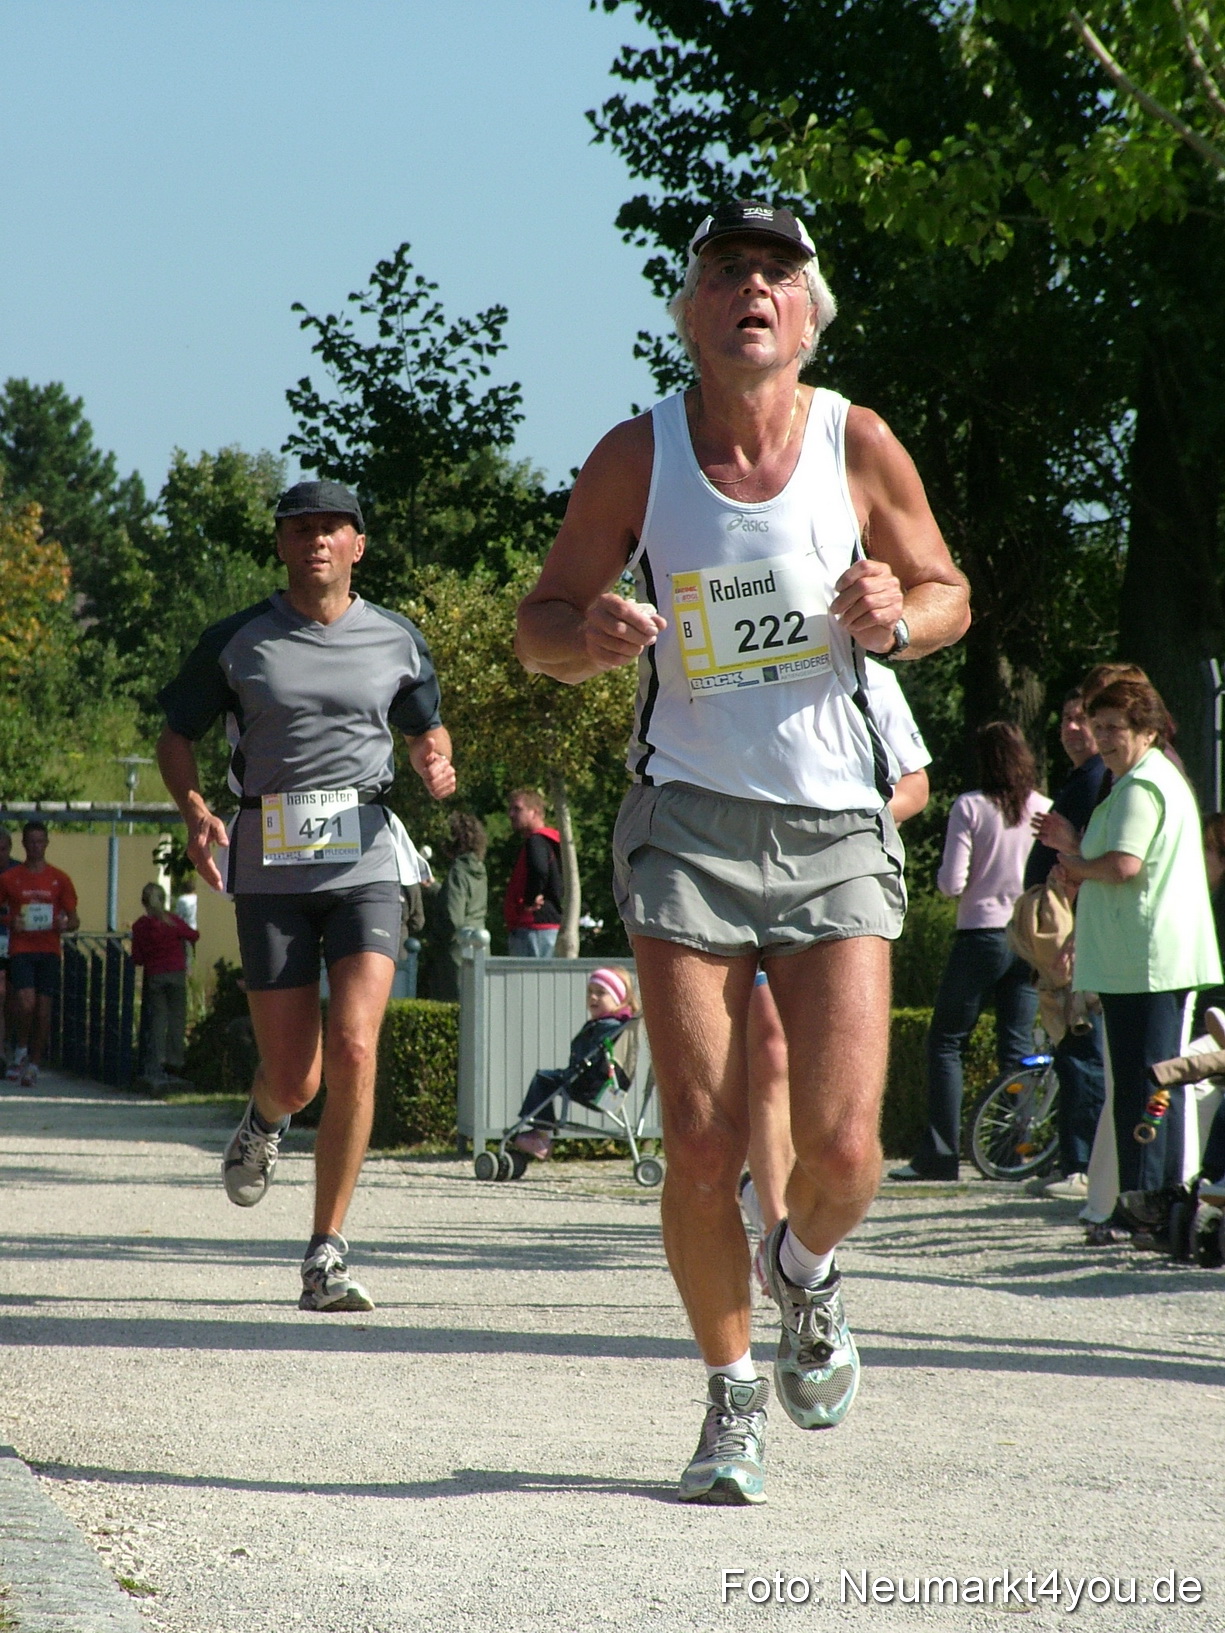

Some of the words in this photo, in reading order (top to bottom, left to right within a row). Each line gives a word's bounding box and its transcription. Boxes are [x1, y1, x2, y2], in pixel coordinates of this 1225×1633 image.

[742, 520, 769, 532] asics
[709, 570, 776, 602] Roland
[683, 621, 693, 638] B
[734, 611, 809, 653] 222
[779, 653, 830, 673] PFLEIDERER
[691, 671, 743, 690] BOCK
[286, 792, 316, 805] hans
[320, 790, 353, 806] peter
[299, 816, 342, 838] 471
